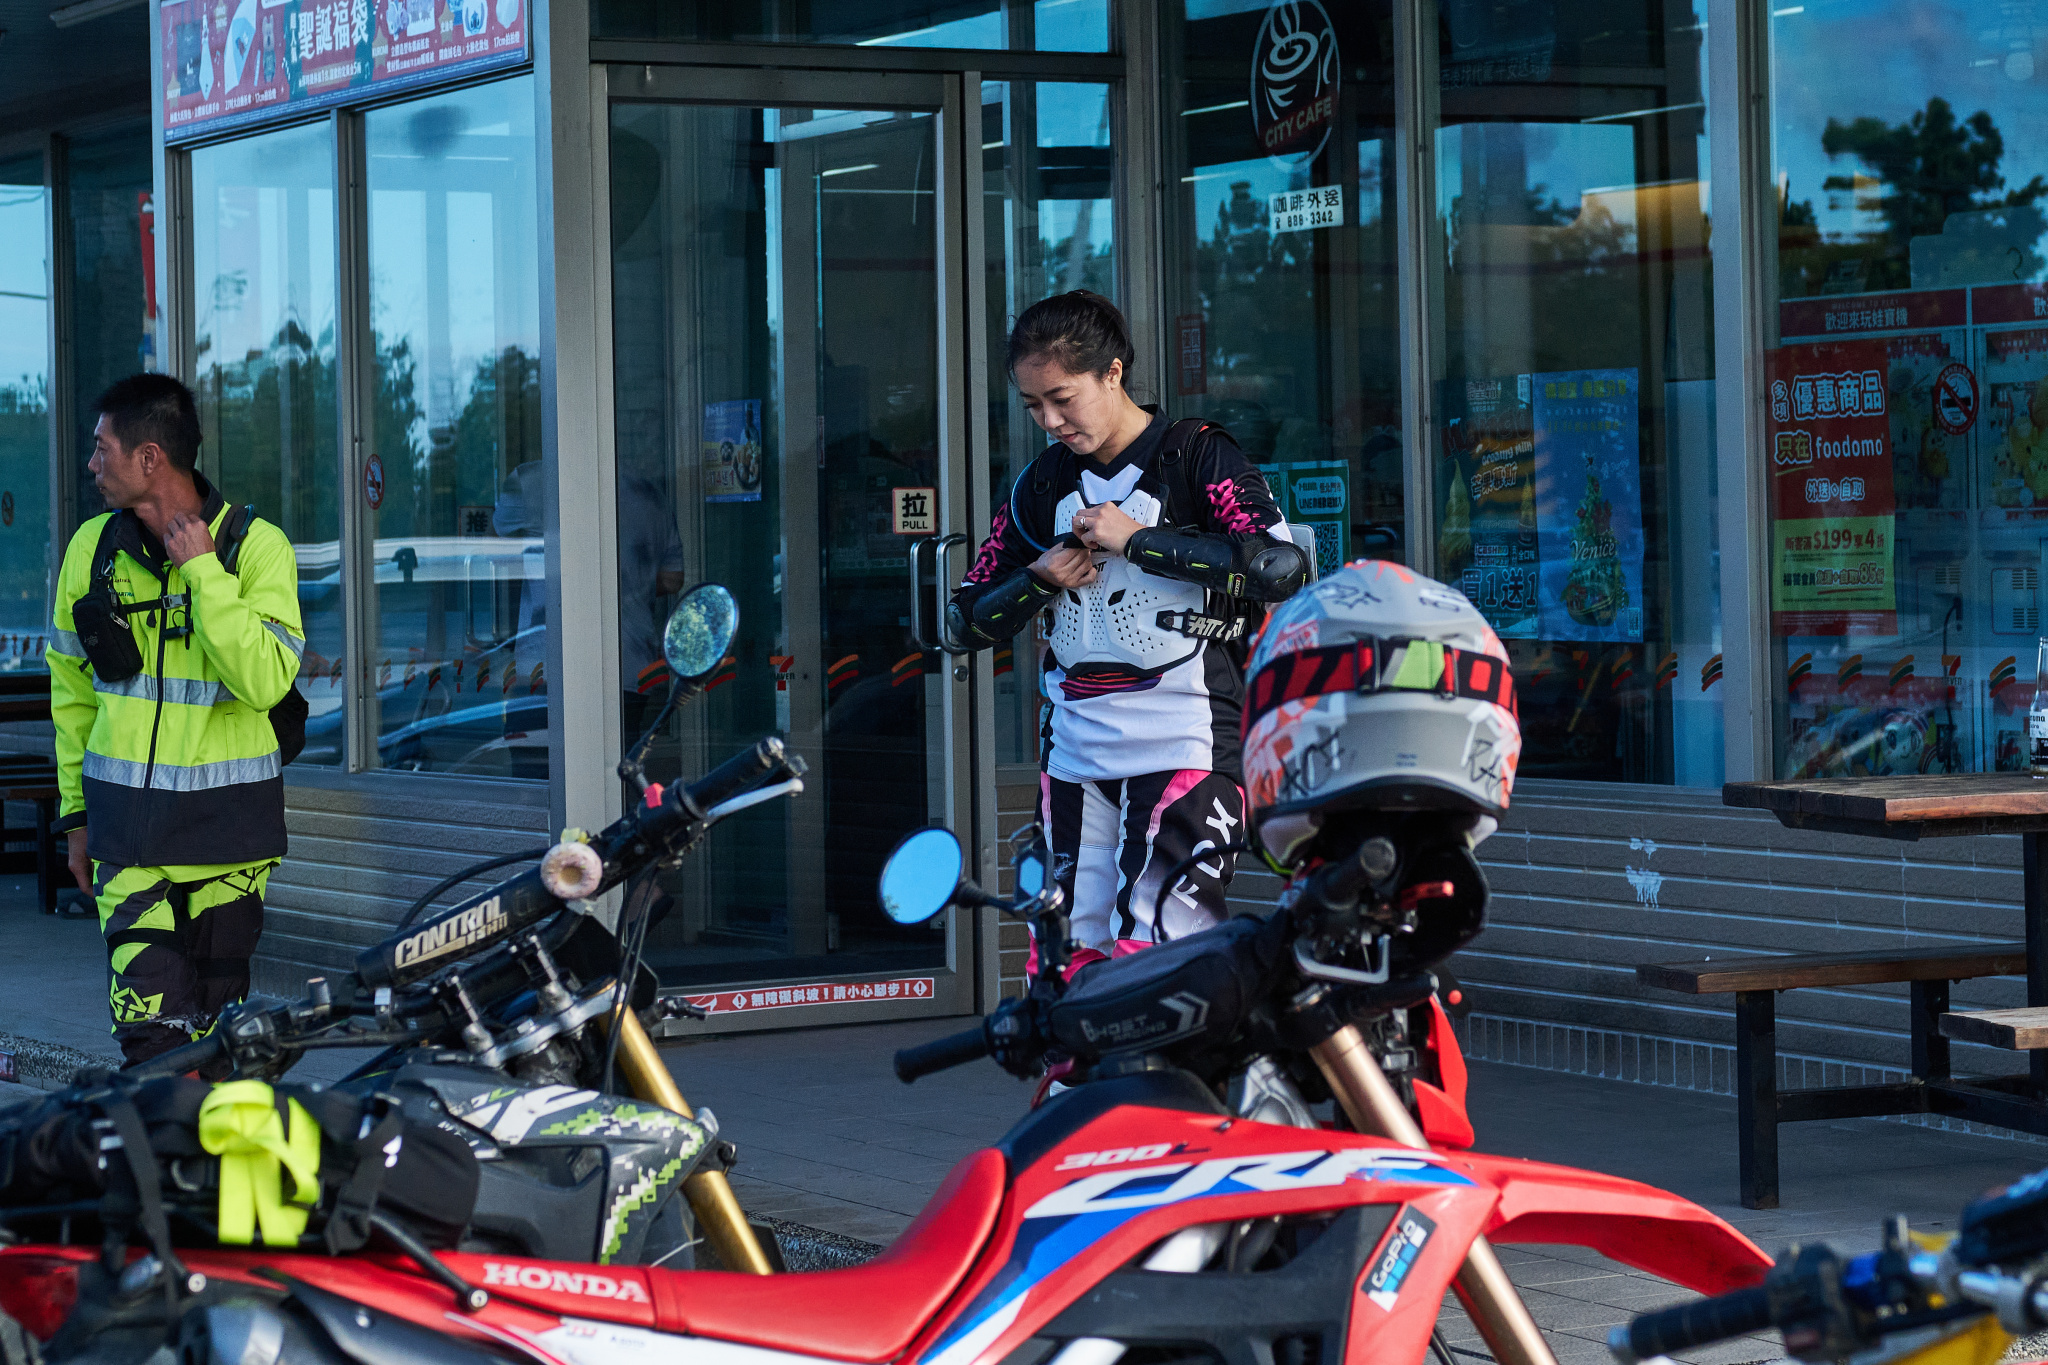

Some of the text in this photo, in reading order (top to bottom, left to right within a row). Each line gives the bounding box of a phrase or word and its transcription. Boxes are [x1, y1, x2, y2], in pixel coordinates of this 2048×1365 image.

[299, 0, 369, 59] 聖誕福袋
[1265, 96, 1332, 148] CITY CAFE
[1273, 189, 1340, 213] 咖啡外送
[1771, 373, 1884, 420] 多項 優惠商品
[1777, 433, 1883, 462] 只在 foodomo
[466, 511, 488, 533] 推
[902, 493, 928, 517] 拉
[902, 521, 928, 529] PULL
[1570, 540, 1617, 561] Venice
[1462, 568, 1537, 611] 買1送1
[1188, 615, 1224, 638] EATT
[1171, 796, 1239, 910] FOX
[395, 895, 500, 967] CONTROL
[1023, 1147, 1448, 1219] CRF
[1372, 1219, 1417, 1288] GoPro
[483, 1262, 650, 1304] HONDA
